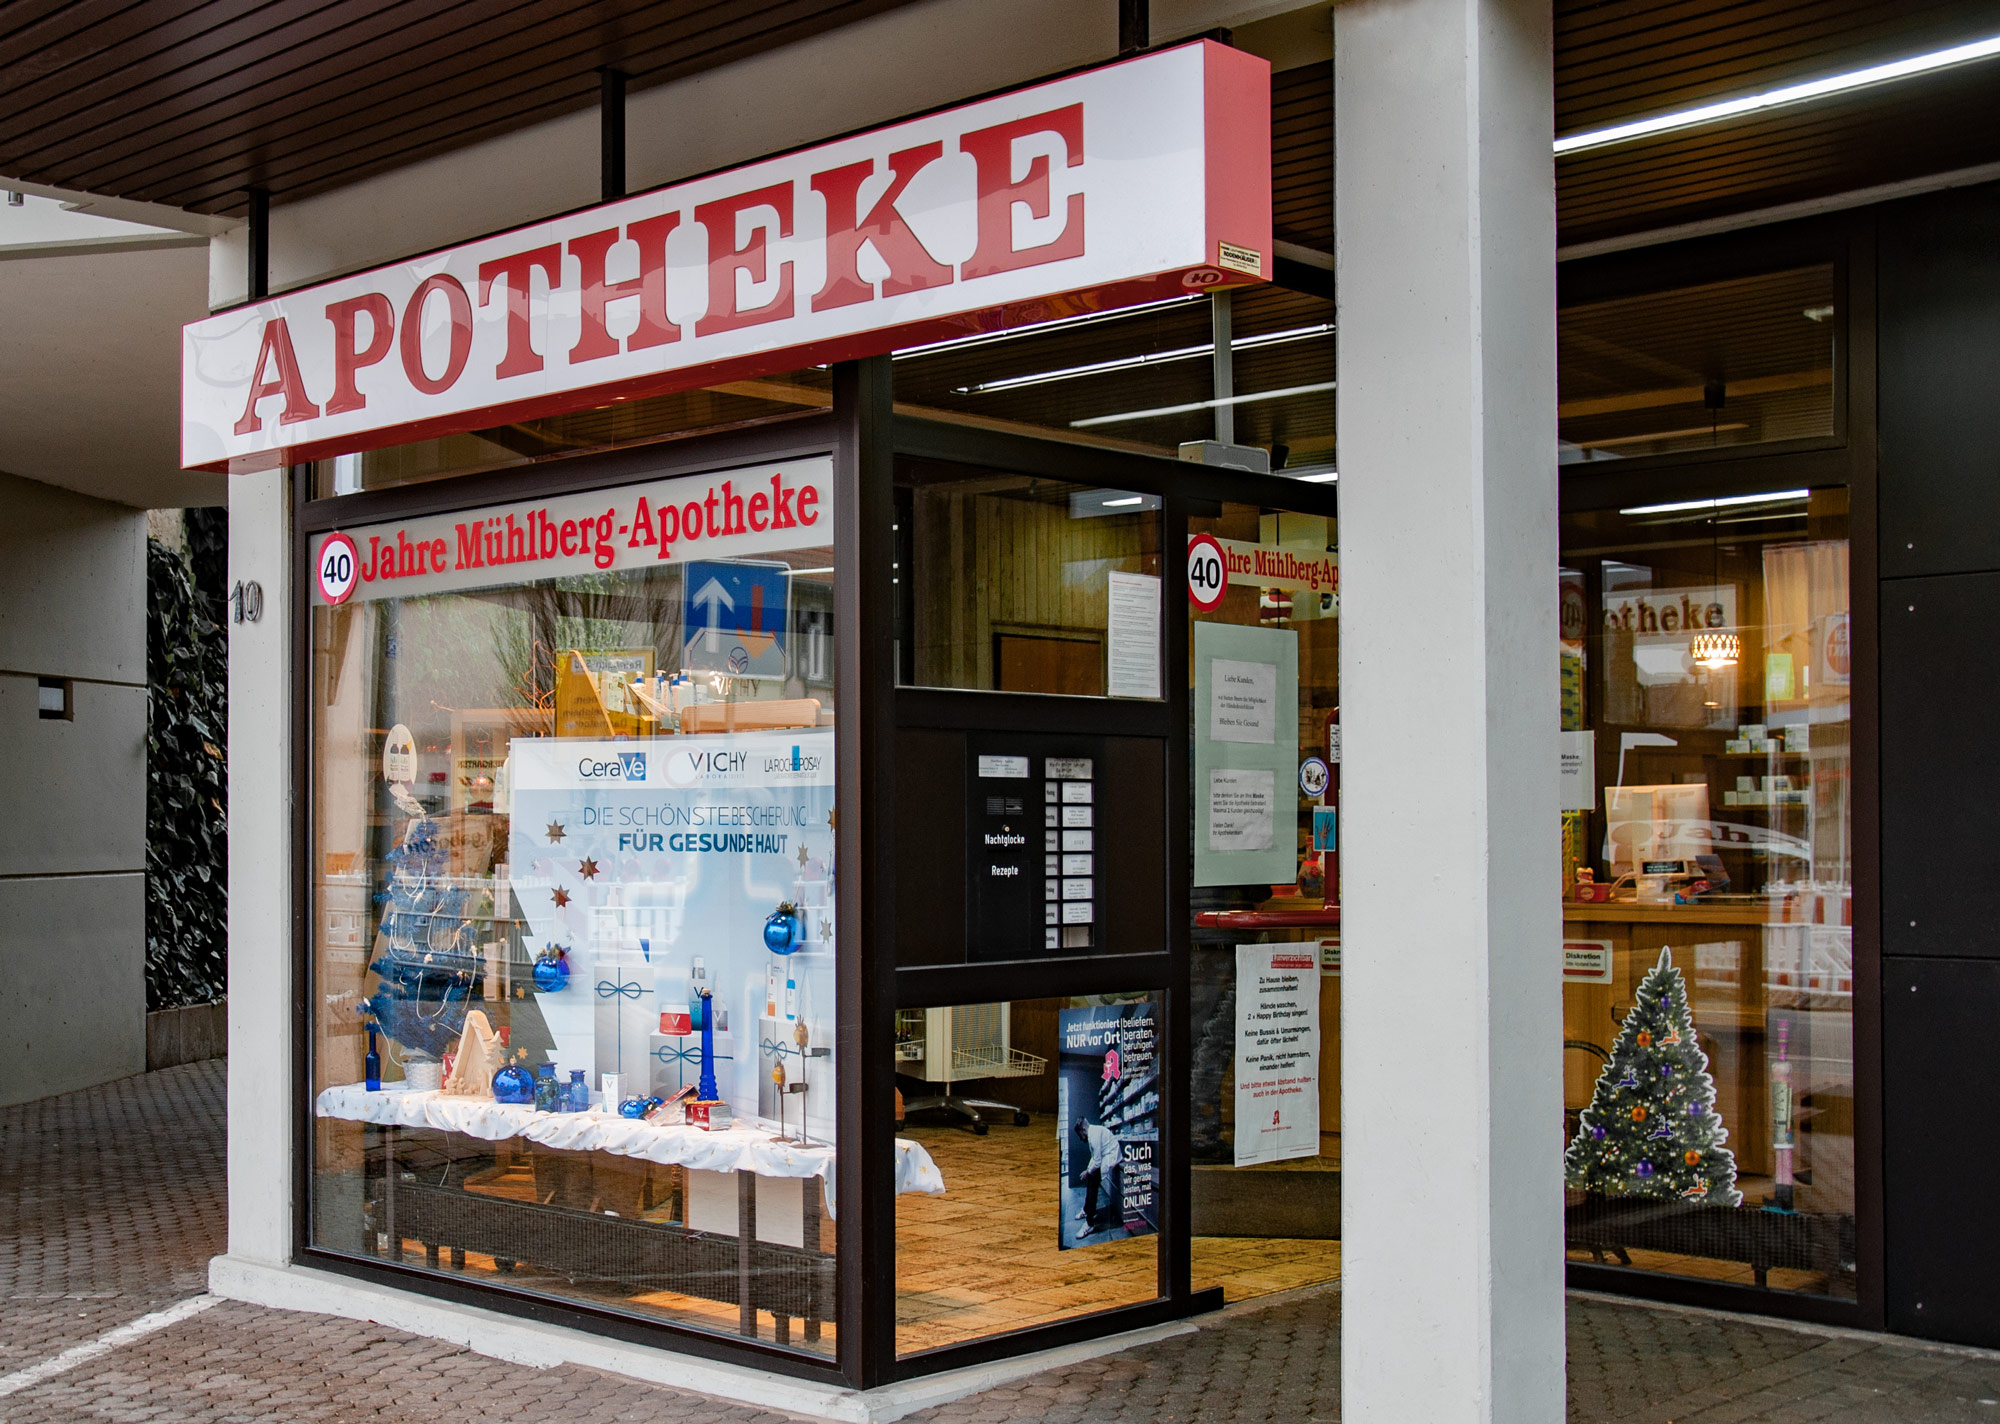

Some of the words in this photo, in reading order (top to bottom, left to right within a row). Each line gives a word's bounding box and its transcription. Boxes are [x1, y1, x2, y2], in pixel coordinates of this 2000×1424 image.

[234, 102, 1084, 436] APOTHEKE
[323, 553, 351, 583] 40
[361, 530, 447, 583] Jahre
[454, 472, 820, 569] Mühlberg-Apotheke
[1191, 557, 1220, 589] 40
[1224, 546, 1251, 574] hre
[229, 580, 262, 624] 10
[578, 756, 645, 778] CeraVe
[688, 751, 748, 772] VICHY
[584, 806, 613, 826] DIE
[619, 802, 730, 826] SCHÖNSTE
[732, 805, 807, 827] BESCHERUNG
[619, 828, 664, 852] FÜR
[669, 833, 753, 854] GESUNDE
[756, 834, 788, 854] HAUT
[984, 833, 1025, 847] Nachtglocke
[991, 865, 1019, 877] Rezepte
[1259, 976, 1265, 984] Zu
[1282, 975, 1299, 983] bleiben,
[1259, 984, 1299, 993] zusammenhalten!
[1277, 1001, 1297, 1009] waschen,
[1257, 1012, 1272, 1020] Happy
[1273, 1010, 1291, 1018] Birthday
[1292, 1009, 1308, 1017] singen!
[1066, 1022, 1082, 1033] Jetzt
[1083, 1018, 1120, 1031] funktioniert
[1123, 1016, 1154, 1028] beliefern.
[1123, 1028, 1154, 1041] beraten.
[1259, 1028, 1275, 1036] Bussis
[1281, 1026, 1311, 1034] Umarmungen,
[1066, 1034, 1086, 1048] NUR
[1087, 1035, 1102, 1046] vor
[1104, 1031, 1120, 1045] Ort
[1270, 1036, 1281, 1044] öfter
[1282, 1035, 1299, 1043] lächeln!
[1123, 1040, 1154, 1052] beruhigen.
[1123, 1052, 1154, 1062] betreuen.
[1260, 1054, 1274, 1062] Panik,
[1287, 1051, 1311, 1059] hamstern,
[1259, 1063, 1279, 1071] einander
[1280, 1061, 1295, 1069] helfen!
[1251, 1081, 1261, 1089] bitte
[1263, 1080, 1276, 1088] etwas
[1277, 1078, 1296, 1086] Abstand
[1253, 1090, 1264, 1098] auch
[1265, 1089, 1269, 1097] in
[1270, 1088, 1278, 1096] der
[1279, 1086, 1303, 1095] Apotheke.
[1124, 1142, 1152, 1162] Such
[1123, 1163, 1137, 1174] das,
[1138, 1162, 1152, 1172] was
[1123, 1176, 1132, 1184] wir
[1133, 1173, 1152, 1185] gerade
[1123, 1185, 1141, 1194] leisten,
[1141, 1182, 1152, 1191] mal
[1123, 1193, 1152, 1209] ONLINE
